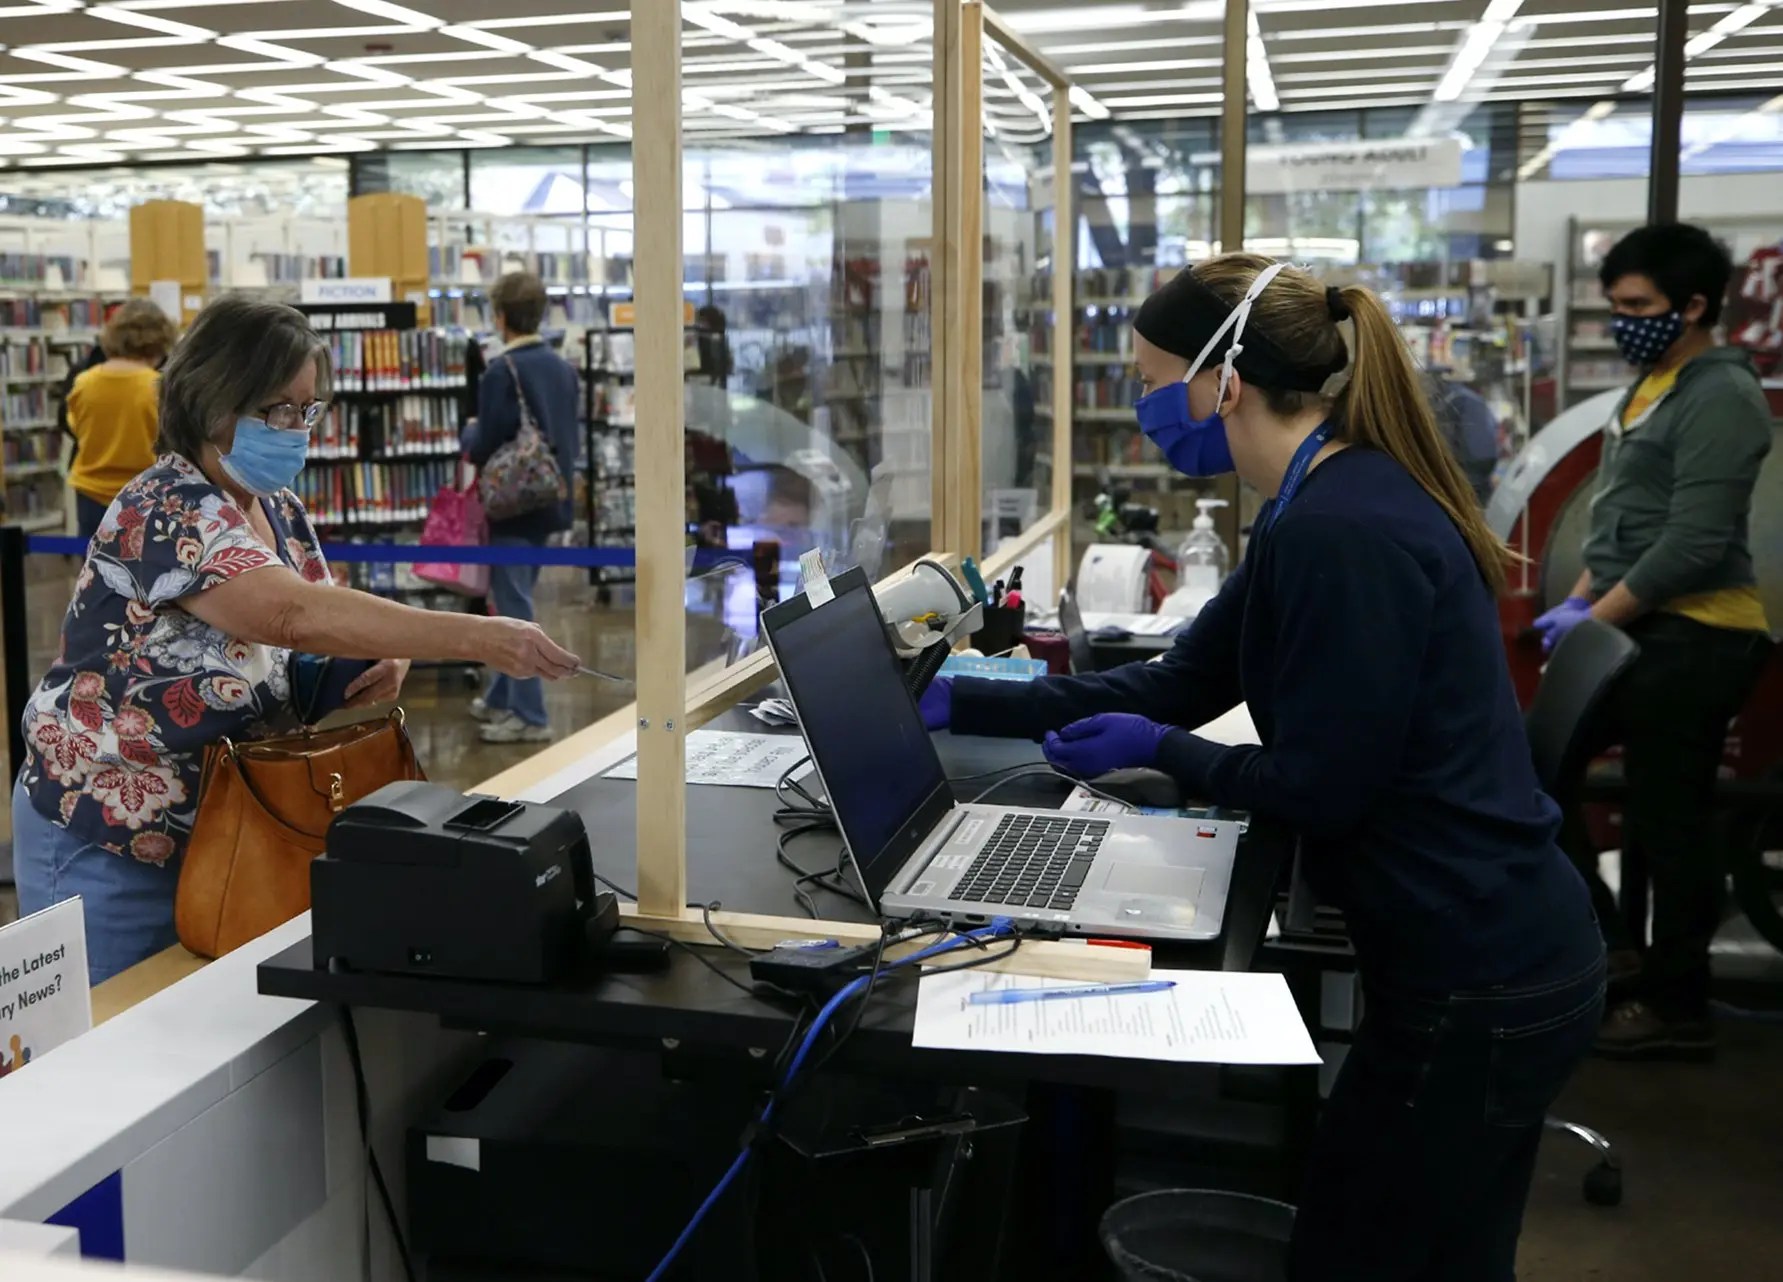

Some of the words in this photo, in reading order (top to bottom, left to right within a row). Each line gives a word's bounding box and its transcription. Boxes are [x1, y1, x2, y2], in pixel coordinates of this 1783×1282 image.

[318, 284, 377, 298] FICTION
[23, 943, 66, 975] Latest
[0, 1002, 15, 1021] ry
[18, 973, 62, 1010] News?
